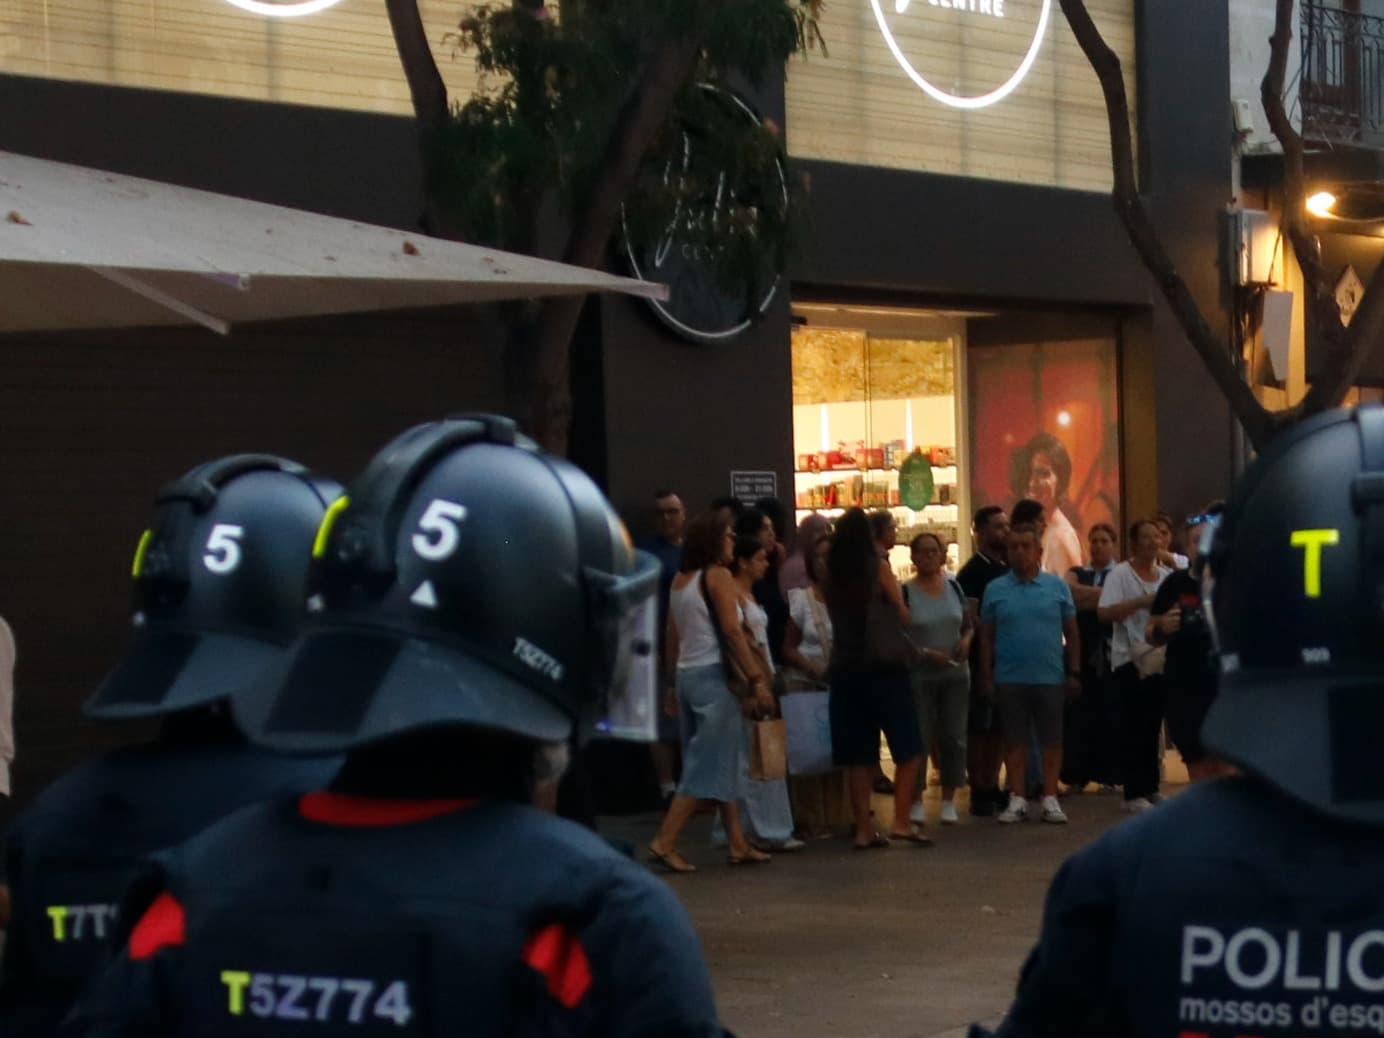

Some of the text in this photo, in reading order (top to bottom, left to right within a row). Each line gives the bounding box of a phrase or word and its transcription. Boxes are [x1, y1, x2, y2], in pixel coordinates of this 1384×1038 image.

[203, 523, 244, 573] 5
[411, 499, 467, 559] 5
[1291, 529, 1339, 598] T
[46, 903, 118, 942] T7T
[221, 970, 412, 1026] T5Z774
[1180, 998, 1291, 1025] mossos
